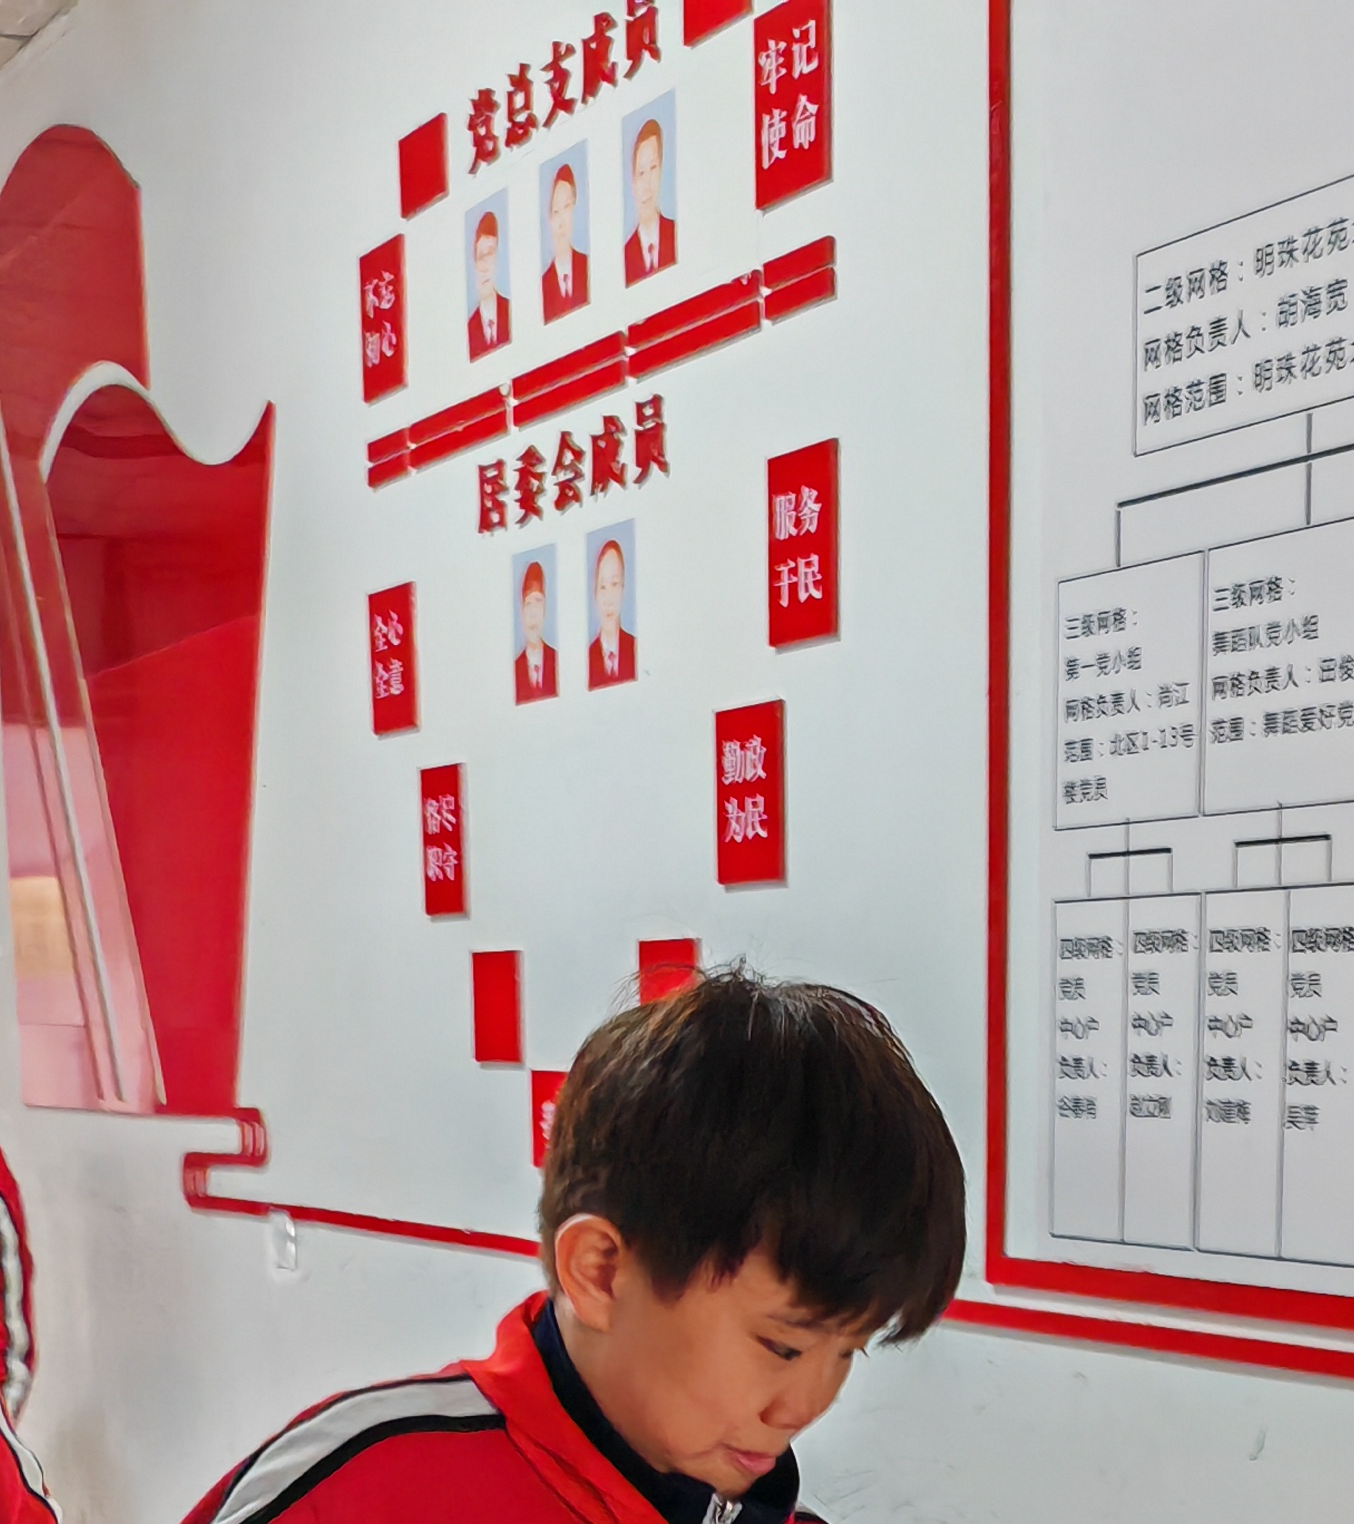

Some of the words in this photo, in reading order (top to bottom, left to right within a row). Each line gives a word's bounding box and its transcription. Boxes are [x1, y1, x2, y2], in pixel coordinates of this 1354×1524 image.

[466, 0, 664, 178] 党总支成员
[757, 19, 820, 97] 牢记
[760, 93, 821, 171] 使命
[475, 392, 672, 538] 居委会成员
[770, 484, 823, 541] 服务
[772, 553, 824, 608] 于民
[723, 792, 768, 844] 为民
